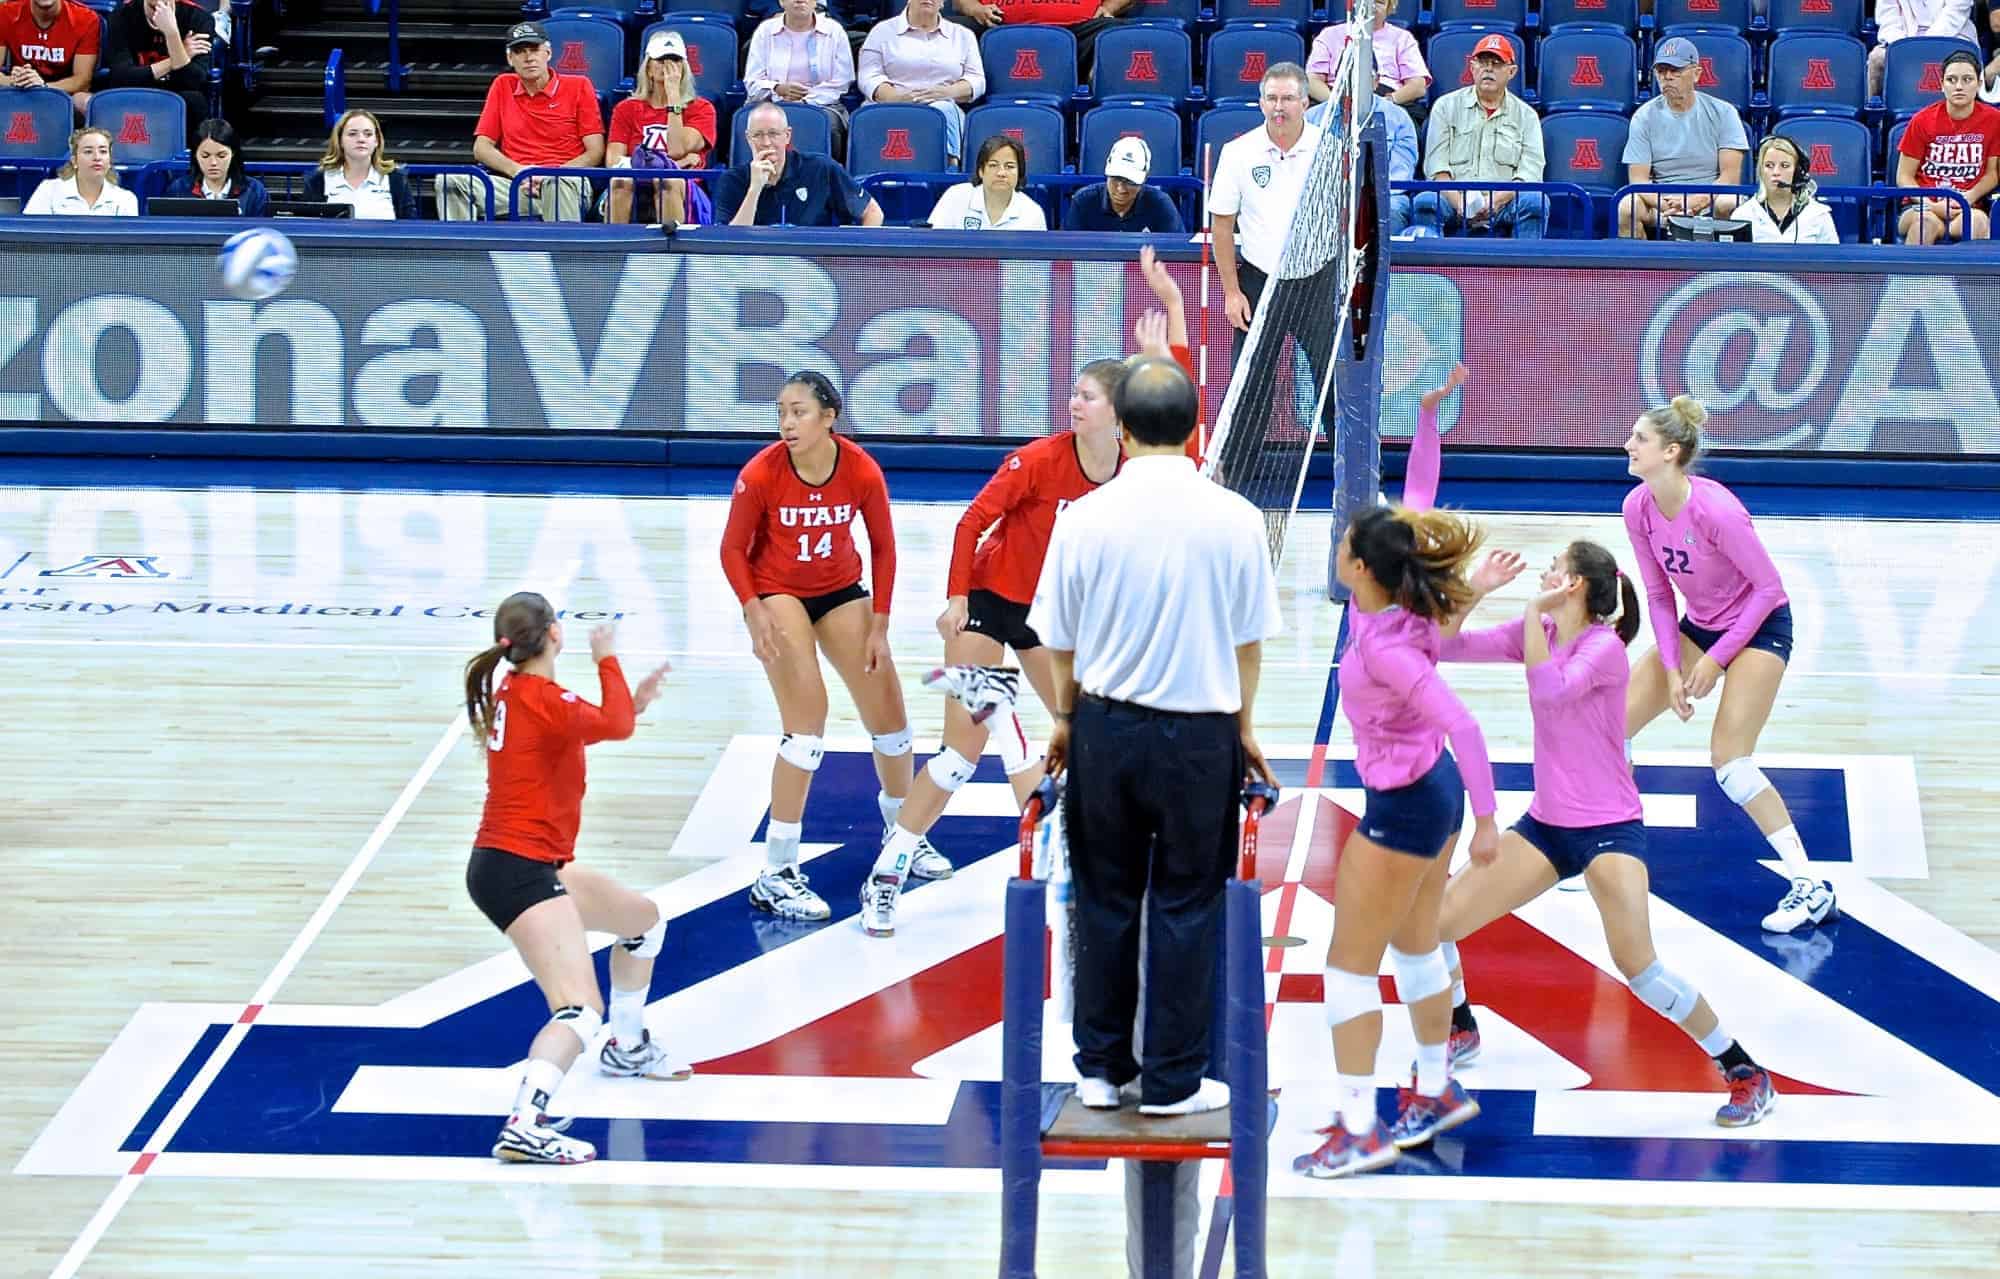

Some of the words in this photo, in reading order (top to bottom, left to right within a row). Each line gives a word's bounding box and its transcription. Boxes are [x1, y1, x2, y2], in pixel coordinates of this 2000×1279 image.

[21, 44, 65, 62] UTAH
[1010, 49, 1043, 80] A
[1125, 51, 1159, 81] A
[1569, 55, 1604, 87] A
[1802, 58, 1836, 89] A
[5, 112, 39, 144] A
[117, 112, 151, 144] A
[881, 129, 915, 160] A
[1570, 138, 1604, 170] A
[1928, 142, 1984, 163] BEAR
[778, 503, 852, 528] UTAH
[796, 531, 833, 562] 14
[1662, 545, 1695, 575] 22
[152, 600, 405, 618] Medical
[423, 605, 640, 620] Ceter
